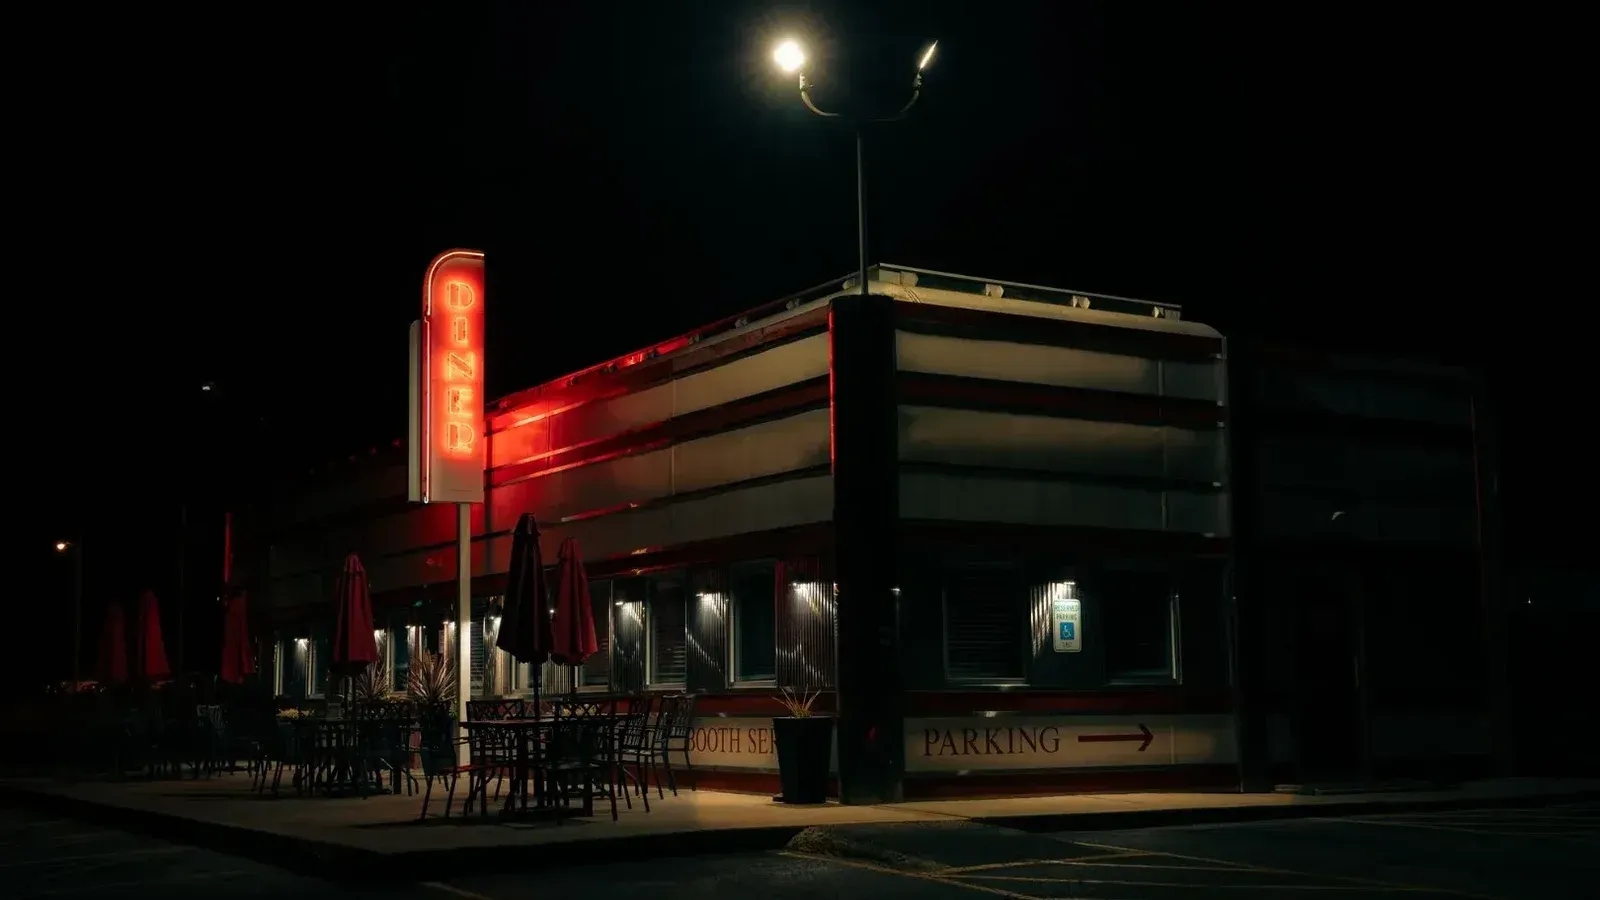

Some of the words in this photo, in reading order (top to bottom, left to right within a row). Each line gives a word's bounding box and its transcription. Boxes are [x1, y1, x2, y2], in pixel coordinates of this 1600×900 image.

[447, 282, 475, 455] DINER
[687, 727, 742, 753] BOOTH
[923, 726, 1061, 756] PARKING
